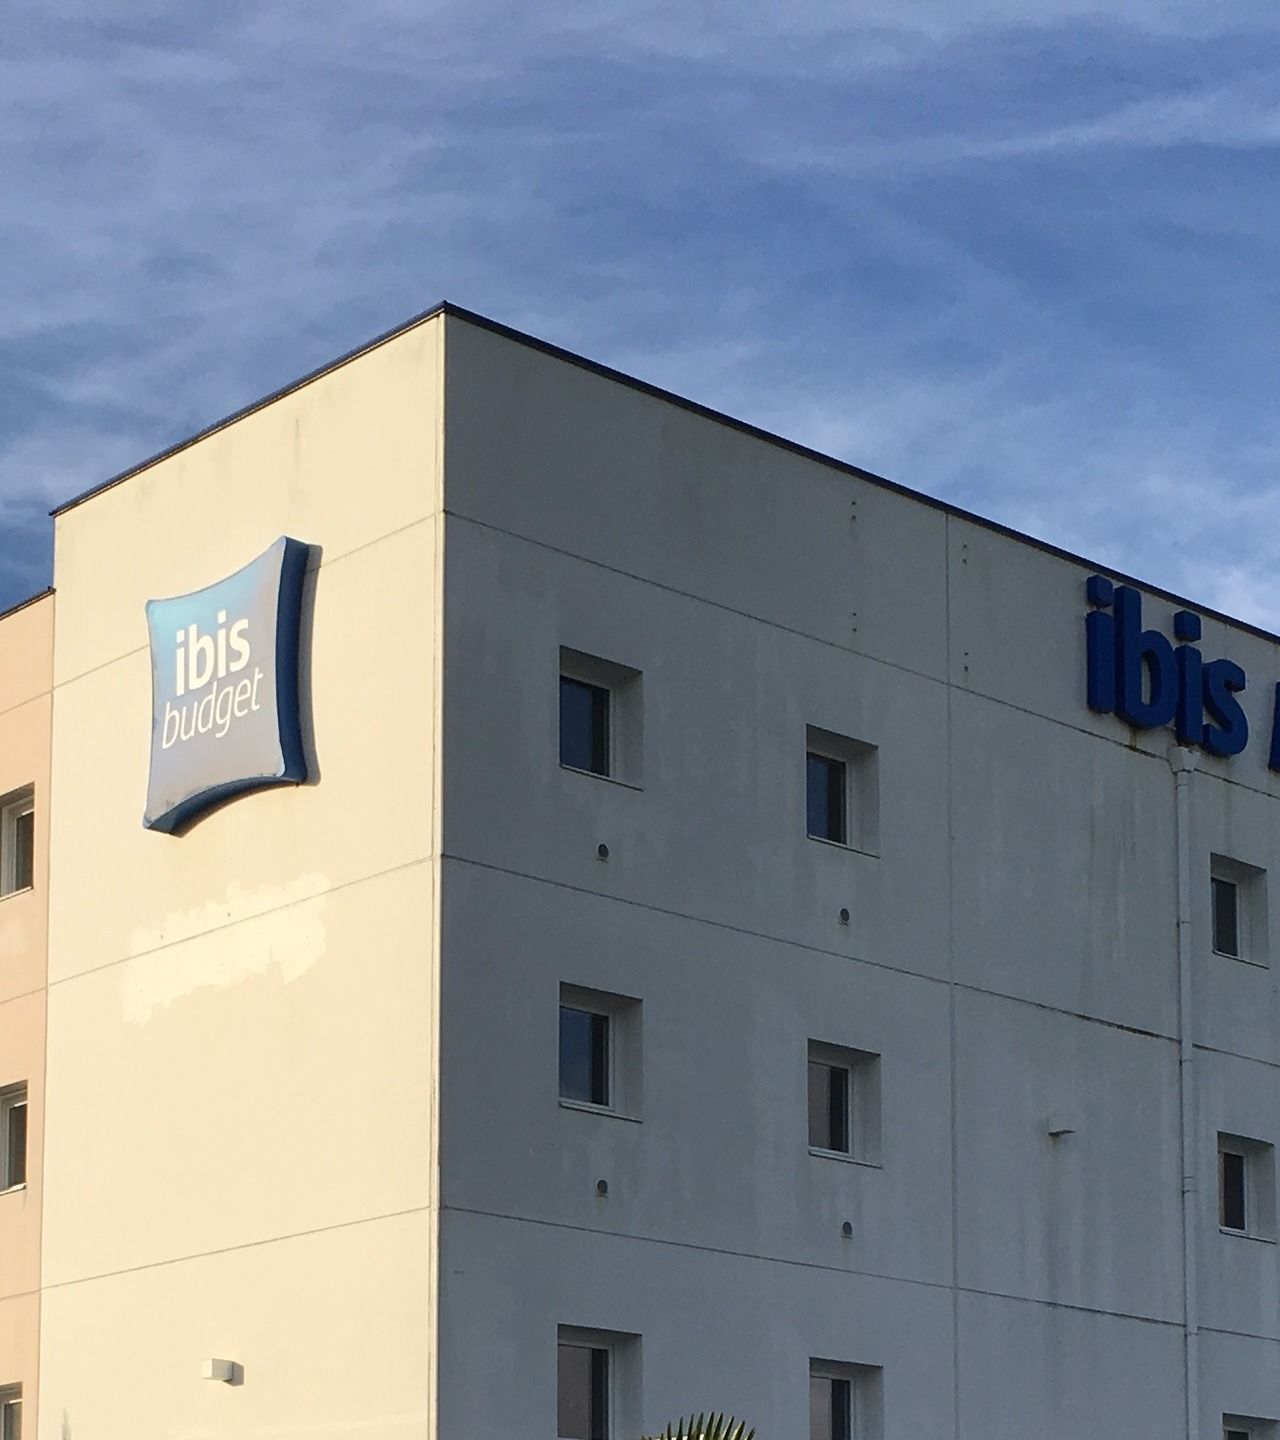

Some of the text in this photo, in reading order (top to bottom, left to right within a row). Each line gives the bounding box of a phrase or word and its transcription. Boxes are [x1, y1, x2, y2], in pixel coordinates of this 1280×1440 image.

[175, 609, 251, 697] ibis
[1086, 574, 1249, 757] ibis
[162, 667, 264, 750] budget
